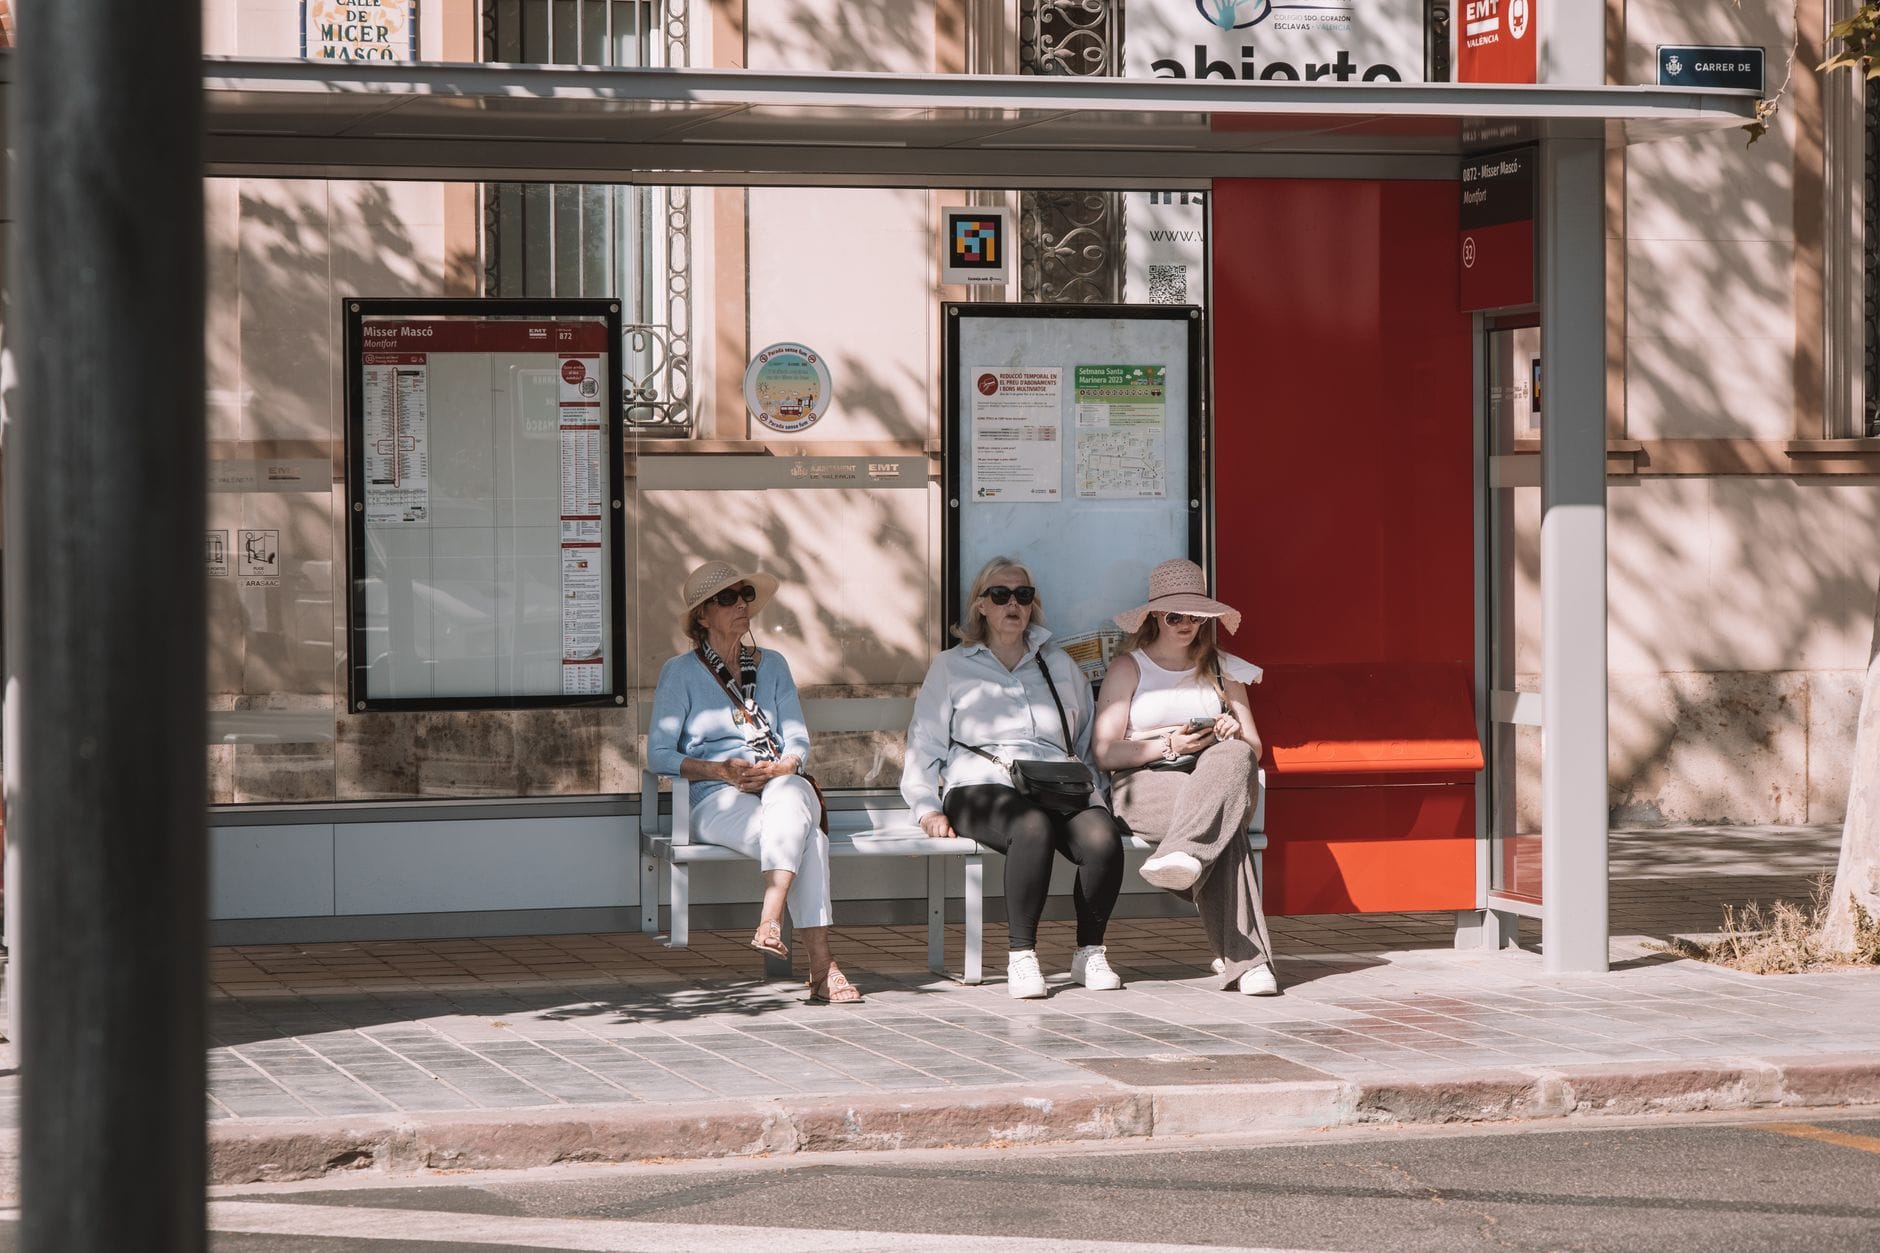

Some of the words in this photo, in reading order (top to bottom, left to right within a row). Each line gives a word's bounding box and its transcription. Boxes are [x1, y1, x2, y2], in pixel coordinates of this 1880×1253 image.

[346, 10, 368, 22] DE
[1466, 0, 1499, 21] EMT
[321, 23, 389, 42] MICER
[1466, 33, 1499, 48] VALÈNCIA
[323, 44, 394, 60] MASCÓ
[1695, 62, 1735, 72] CARRER
[1738, 63, 1751, 72] DE
[1462, 167, 1477, 182] 0872
[1481, 164, 1500, 179] Misser
[1500, 158, 1518, 176] Mascó
[1463, 187, 1487, 205] Montfort
[1465, 245, 1473, 260] 32
[363, 326, 398, 337] Misser
[400, 325, 433, 337] Mascó
[559, 332, 572, 340] 872
[363, 339, 397, 348] Montfort
[1079, 367, 1105, 375] Setmana
[1106, 367, 1124, 375] Santa
[1079, 376, 1107, 384] Marinera
[1108, 376, 1123, 384] 2023
[868, 463, 899, 471] EMT
